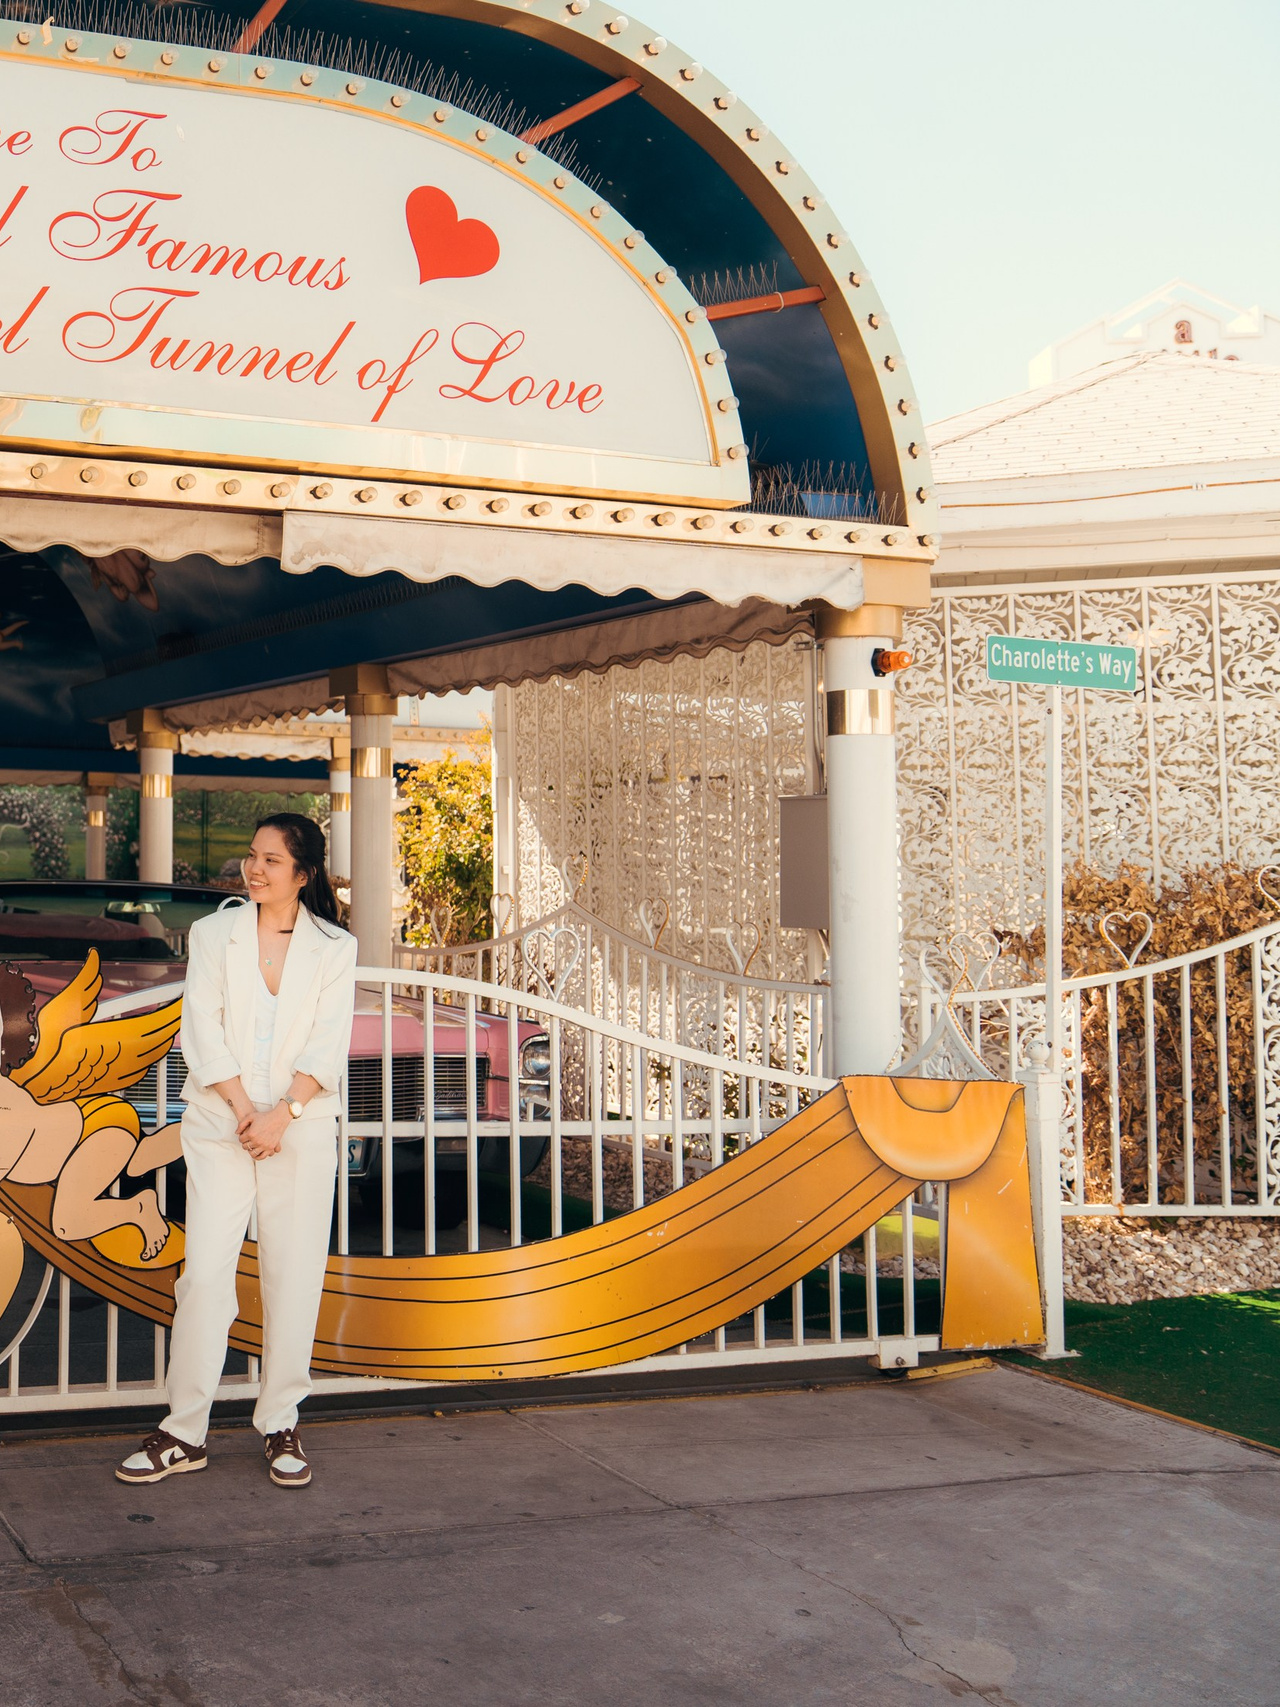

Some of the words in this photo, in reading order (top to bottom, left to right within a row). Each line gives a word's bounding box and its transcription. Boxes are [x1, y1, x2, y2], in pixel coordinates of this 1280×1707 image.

[58, 109, 169, 172] To
[48, 188, 351, 292] Famous
[61, 286, 357, 386] Tunnel
[357, 328, 440, 423] of
[438, 321, 604, 414] Love
[1174, 320, 1193, 344] a
[991, 643, 1094, 674] Charolette's
[1099, 652, 1132, 684] Way
